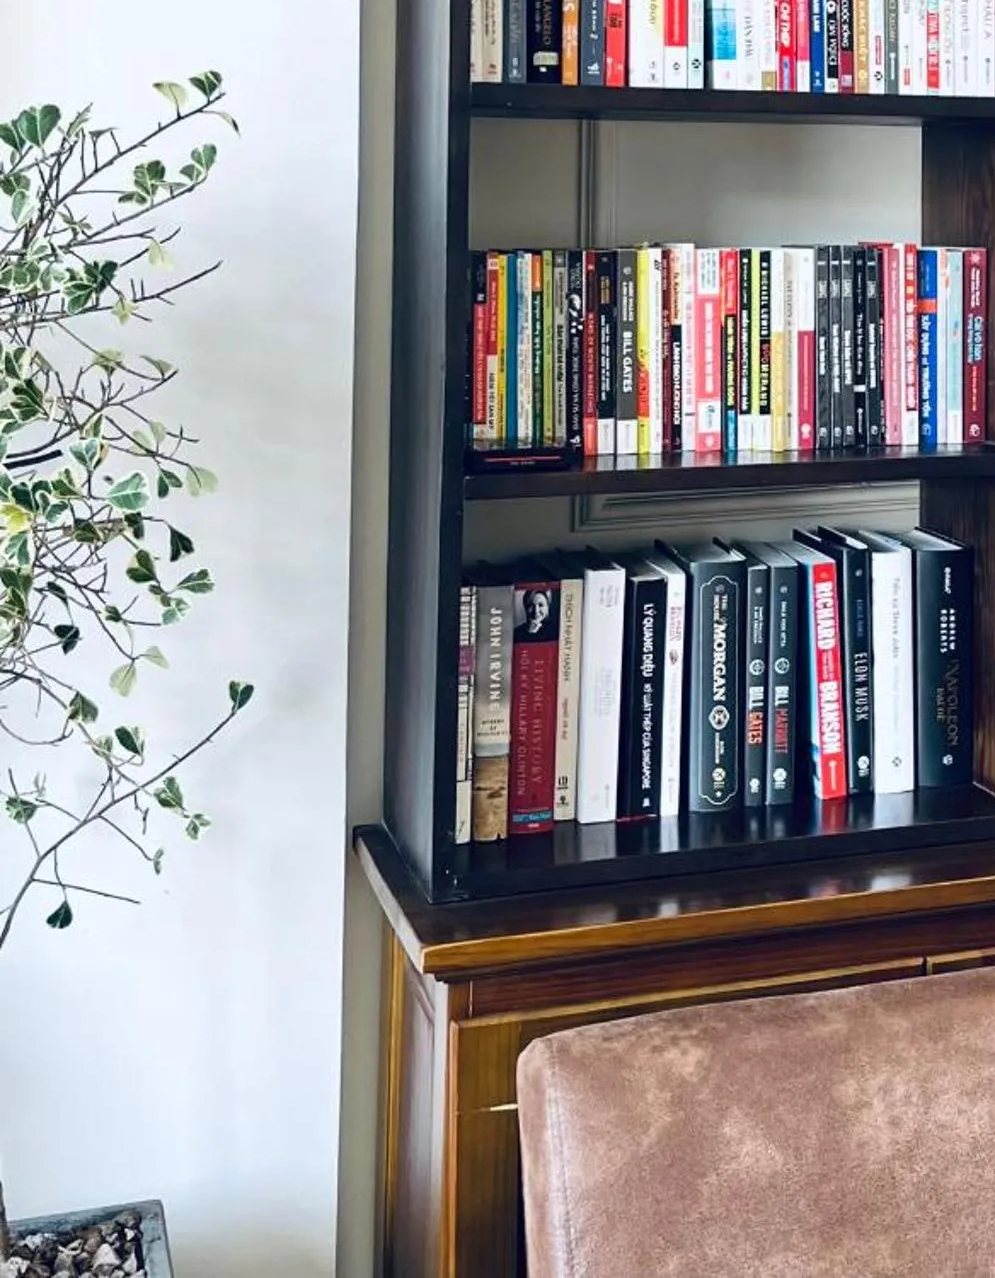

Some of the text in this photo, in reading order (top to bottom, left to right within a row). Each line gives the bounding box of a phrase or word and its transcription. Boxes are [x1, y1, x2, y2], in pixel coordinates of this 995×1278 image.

[761, 308, 769, 336] LEWIS
[622, 331, 633, 393] BILL GATES
[490, 607, 503, 647] JOHN
[643, 603, 656, 615] LÝ
[940, 608, 948, 654] ROBERTS
[948, 608, 956, 651] ANDREW
[643, 616, 653, 653] QUANG
[533, 660, 544, 712] LIVING
[712, 623, 726, 702] MORGAN
[815, 581, 841, 754] RICHARD BRANSON
[774, 685, 789, 707] BILL
[854, 652, 869, 722] ELON MUSK
[945, 658, 959, 746] NAPOLEON
[518, 696, 528, 741] HILLARY
[748, 686, 764, 744] BILL GATES
[517, 745, 527, 796] CLINTON
